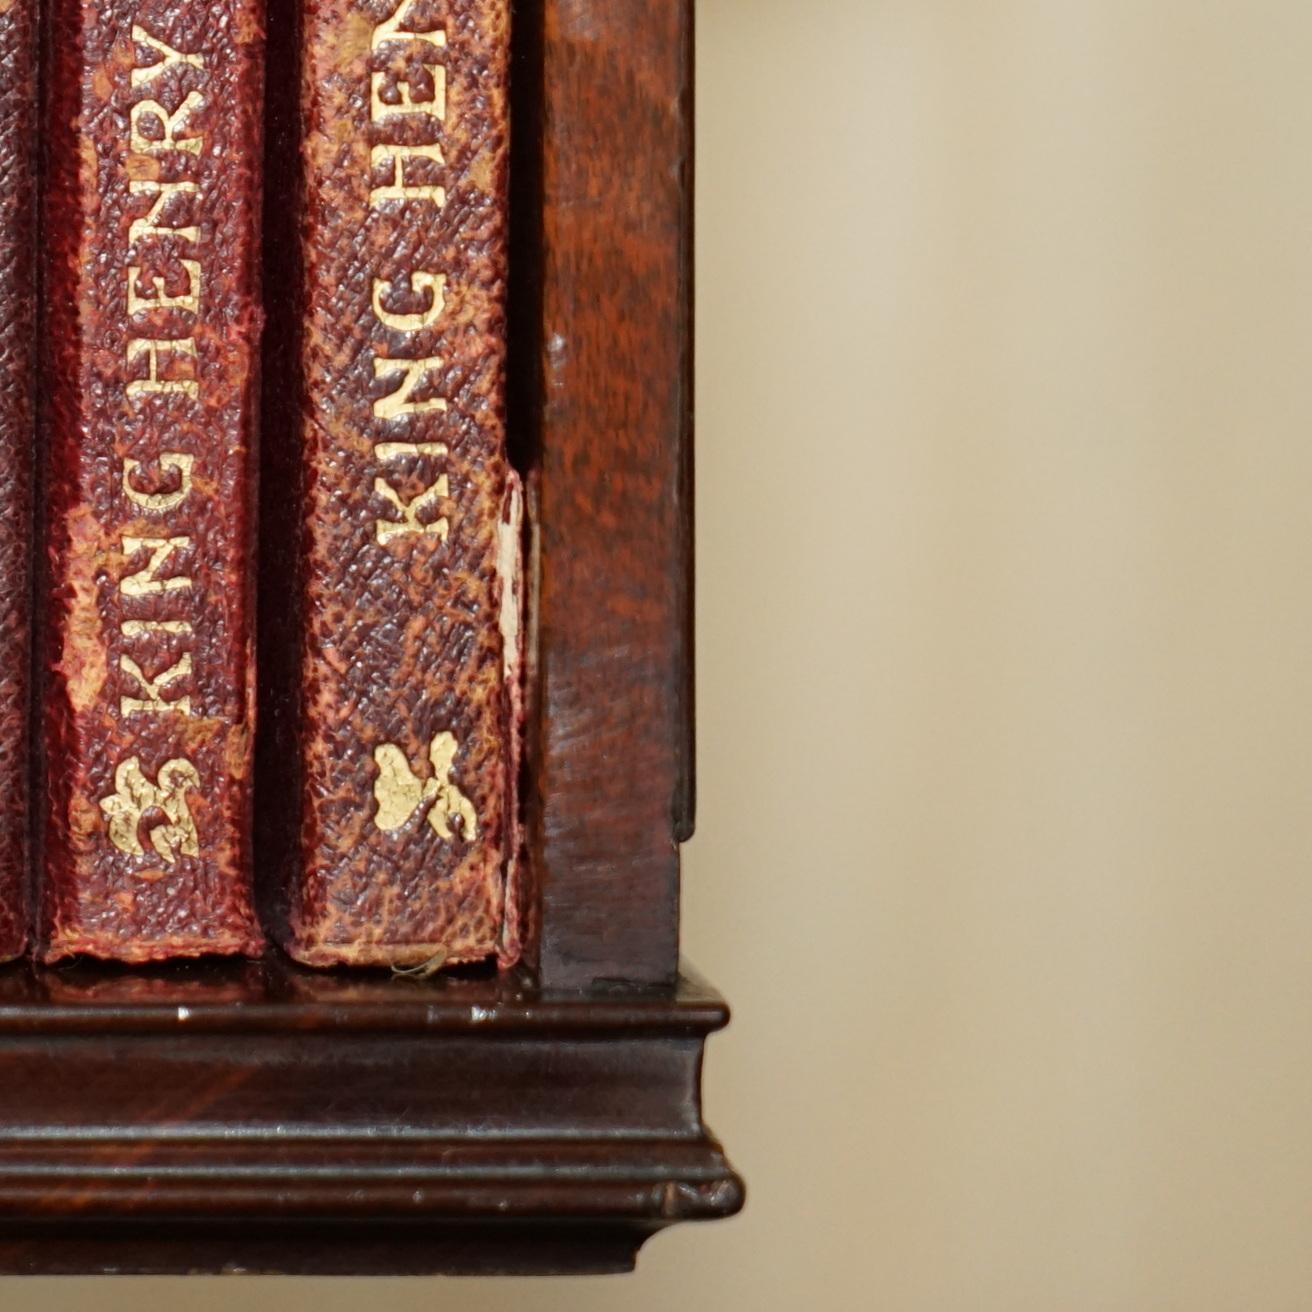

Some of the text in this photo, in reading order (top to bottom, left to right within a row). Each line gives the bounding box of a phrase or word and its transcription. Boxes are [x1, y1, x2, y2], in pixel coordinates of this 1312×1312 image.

[125, 24, 207, 399] HENRY
[371, 270, 450, 544] KING
[119, 452, 195, 717] KING
